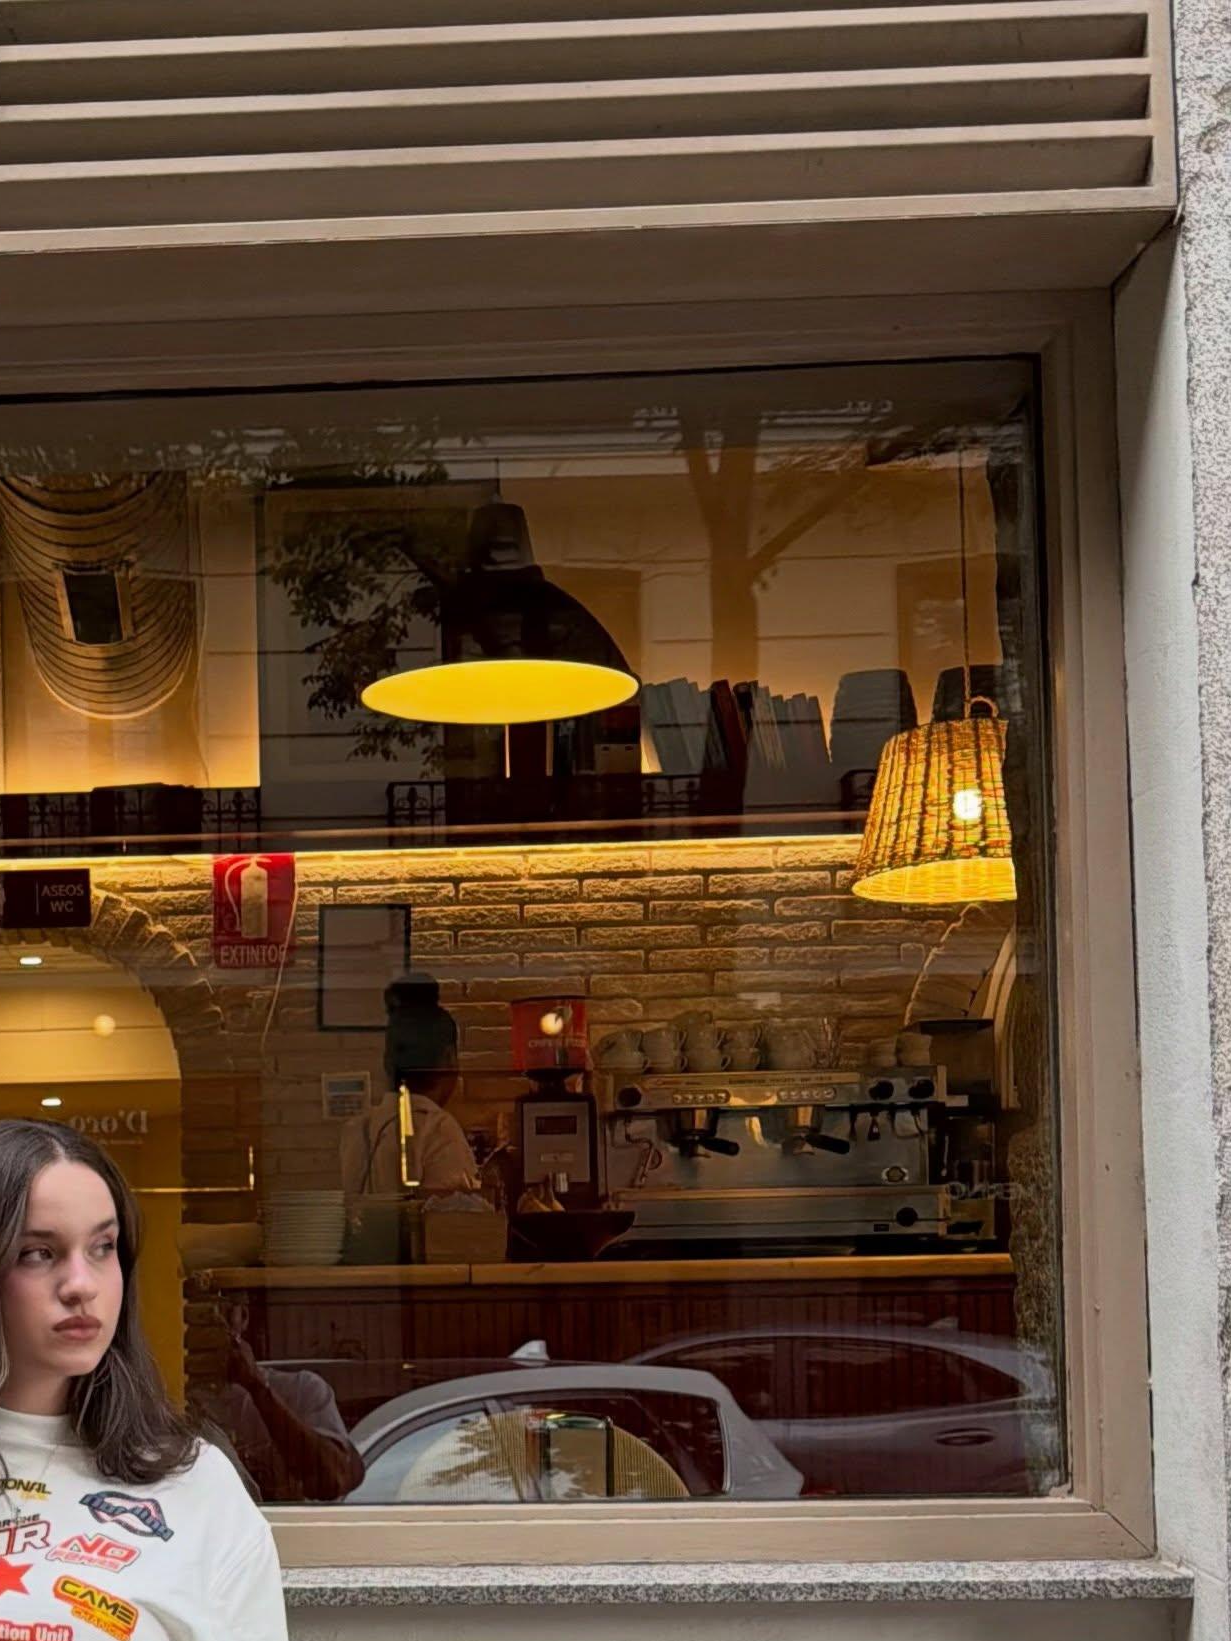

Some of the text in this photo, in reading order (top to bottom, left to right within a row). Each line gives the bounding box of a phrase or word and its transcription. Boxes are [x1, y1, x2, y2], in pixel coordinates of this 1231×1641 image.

[41, 884, 84, 898] ASEOS
[51, 901, 74, 913] WC
[60, 1535, 138, 1562] NO
